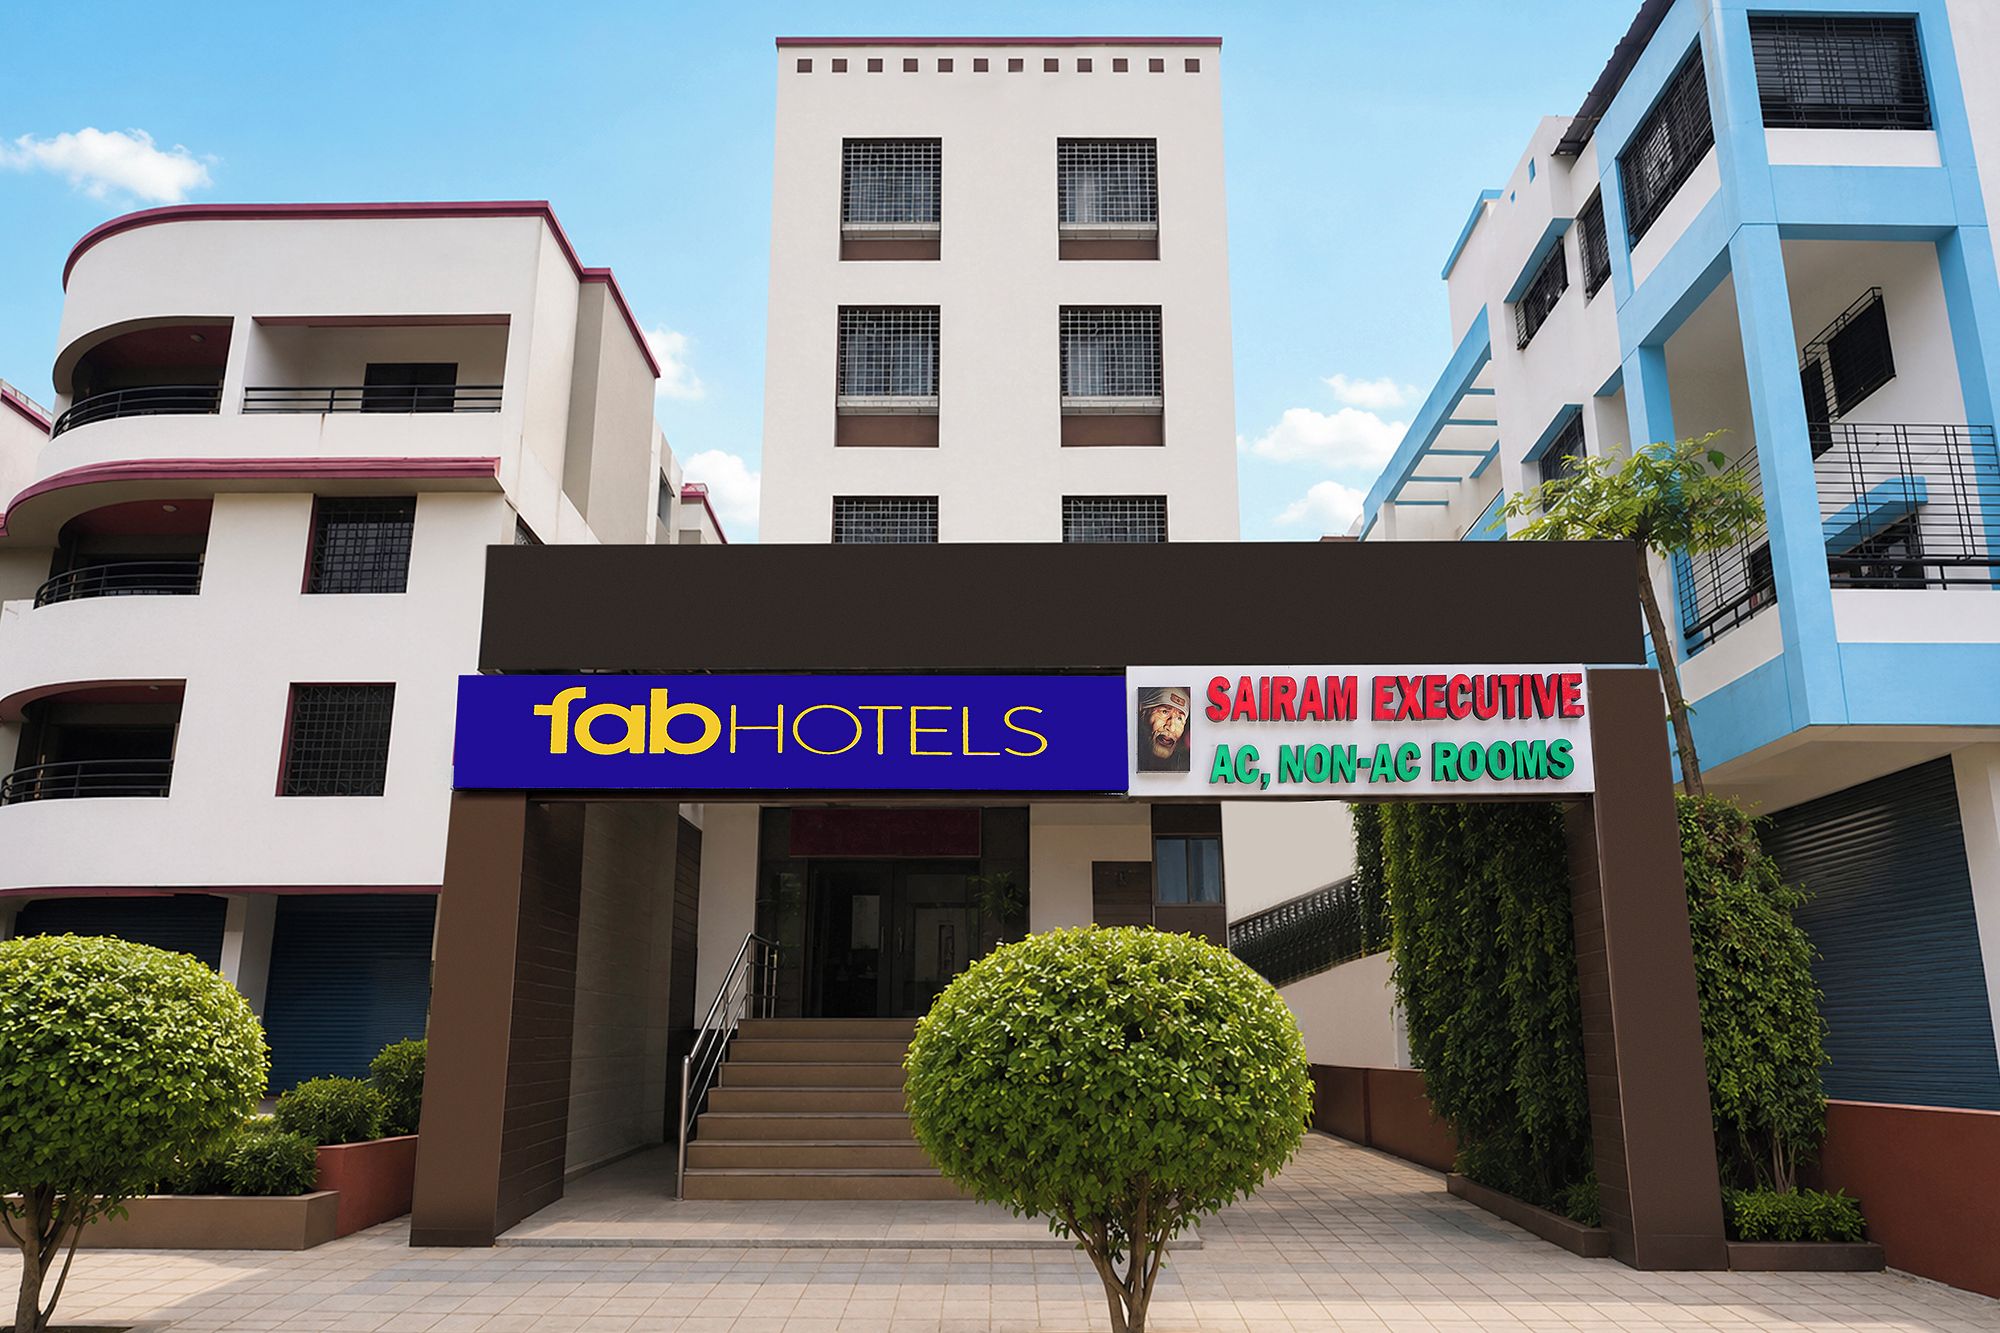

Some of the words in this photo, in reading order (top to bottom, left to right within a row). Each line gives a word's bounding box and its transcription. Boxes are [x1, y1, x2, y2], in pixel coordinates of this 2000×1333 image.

[1205, 675, 1358, 722] SAIRAM
[1371, 673, 1585, 721] EXECUTIVE
[1209, 743, 1271, 790] AC,
[1278, 741, 1422, 784] NON-AC
[1432, 737, 1576, 782] ROOMS
